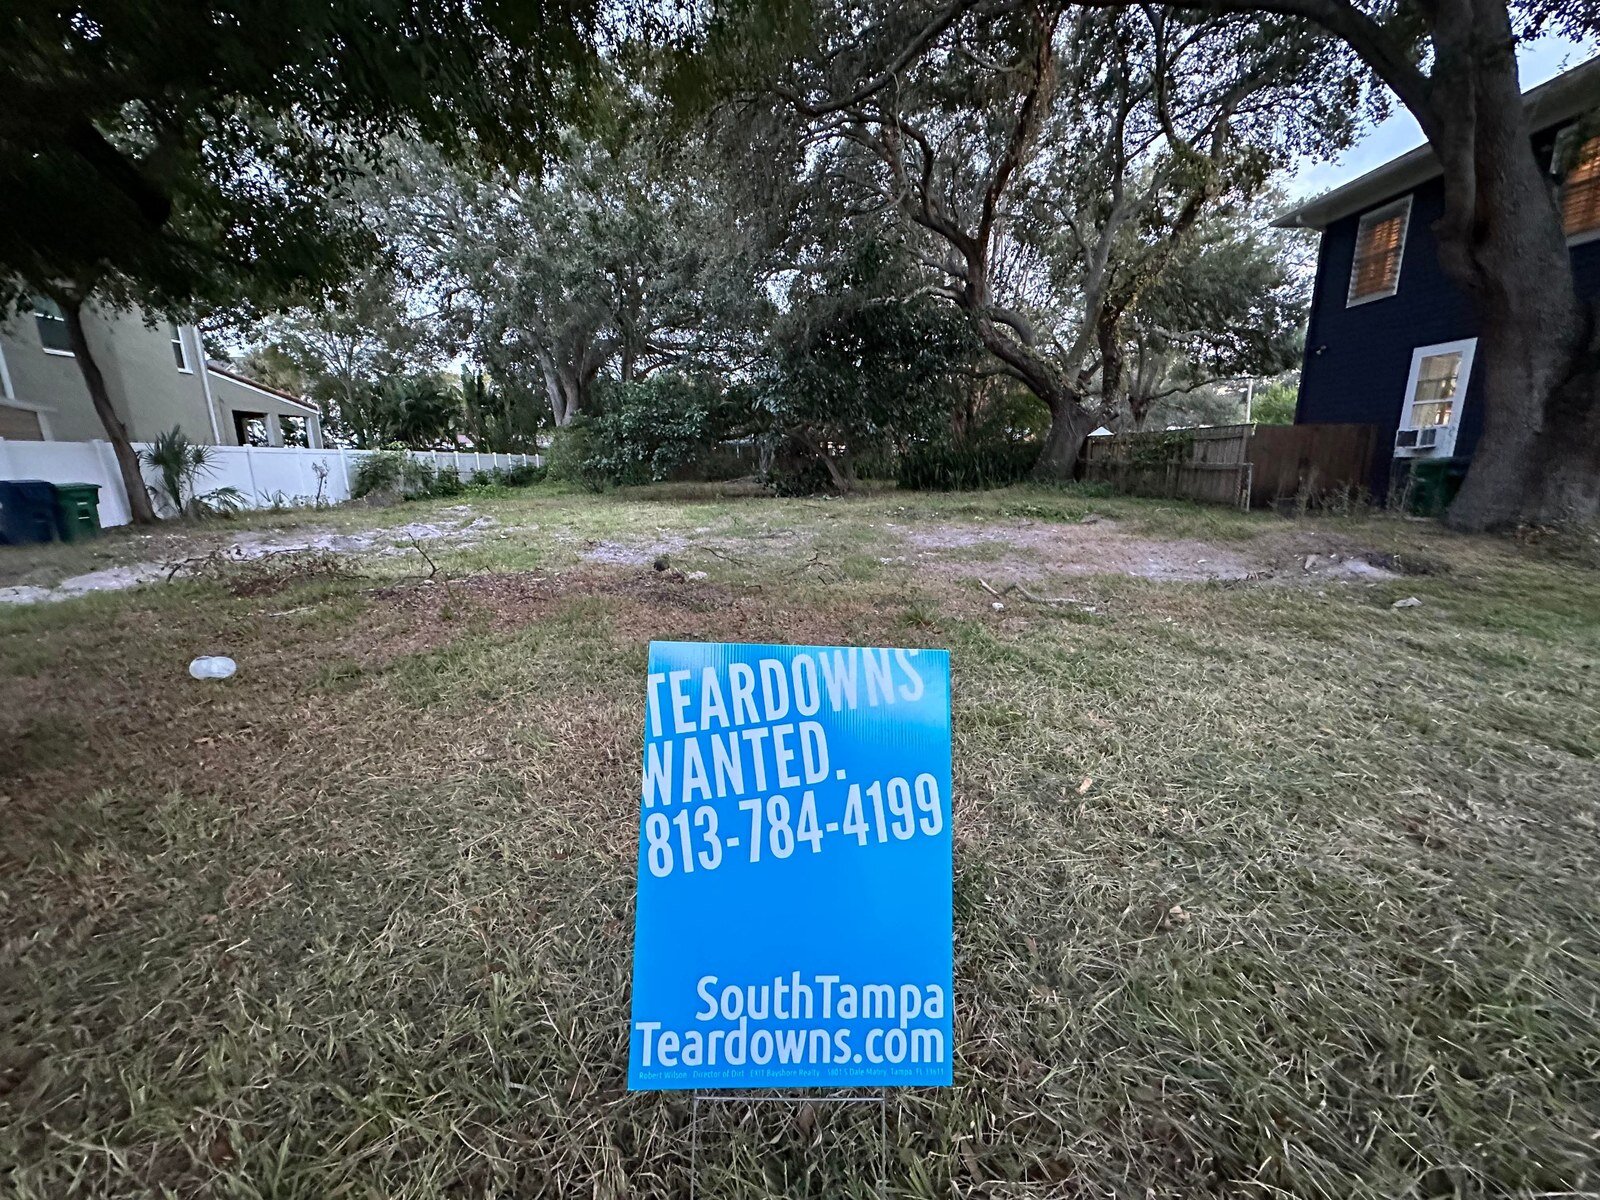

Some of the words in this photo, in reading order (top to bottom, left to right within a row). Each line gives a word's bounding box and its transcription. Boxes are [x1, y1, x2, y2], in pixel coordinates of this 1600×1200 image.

[648, 649, 925, 738] TEARDOWNS
[642, 721, 847, 809] WANTED.
[645, 773, 943, 878] 813-784-4199
[695, 971, 944, 1029] SouthTampa
[635, 1016, 944, 1067] Teardowns.com
[639, 1071, 662, 1080] Robert
[664, 1070, 688, 1079] Wilson
[693, 1069, 721, 1078] Director
[722, 1069, 730, 1078] of
[731, 1069, 744, 1078] Dirt
[750, 1069, 764, 1078] EXIT
[766, 1068, 797, 1079] Bayshore
[799, 1068, 820, 1078] Realty
[849, 1067, 864, 1076] Dale
[865, 1068, 887, 1077] Mabry
[890, 1067, 912, 1077] Tampa
[915, 1067, 922, 1076] FL
